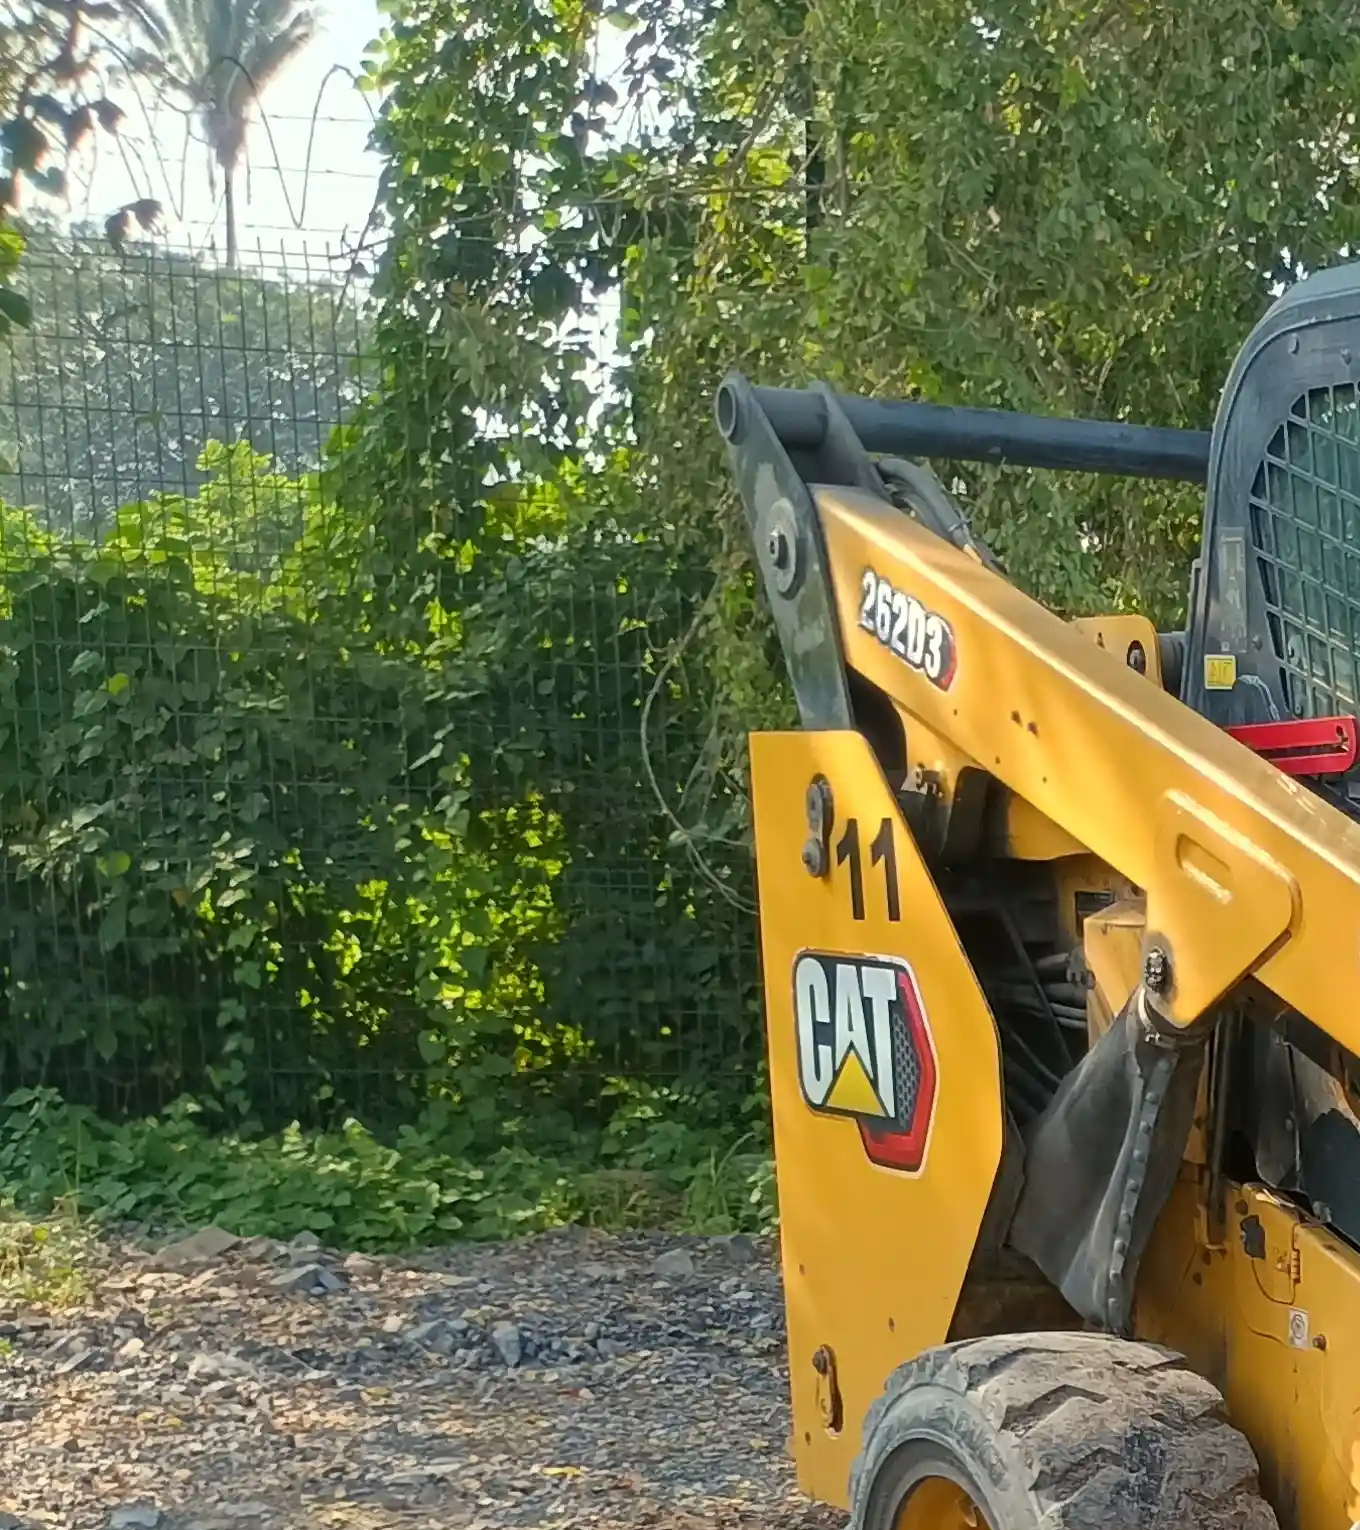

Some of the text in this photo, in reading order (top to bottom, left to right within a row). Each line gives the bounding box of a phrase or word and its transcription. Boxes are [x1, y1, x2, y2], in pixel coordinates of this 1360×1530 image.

[858, 569, 944, 679] 262D3
[836, 817, 901, 922] 11
[795, 957, 898, 1118] CAT
